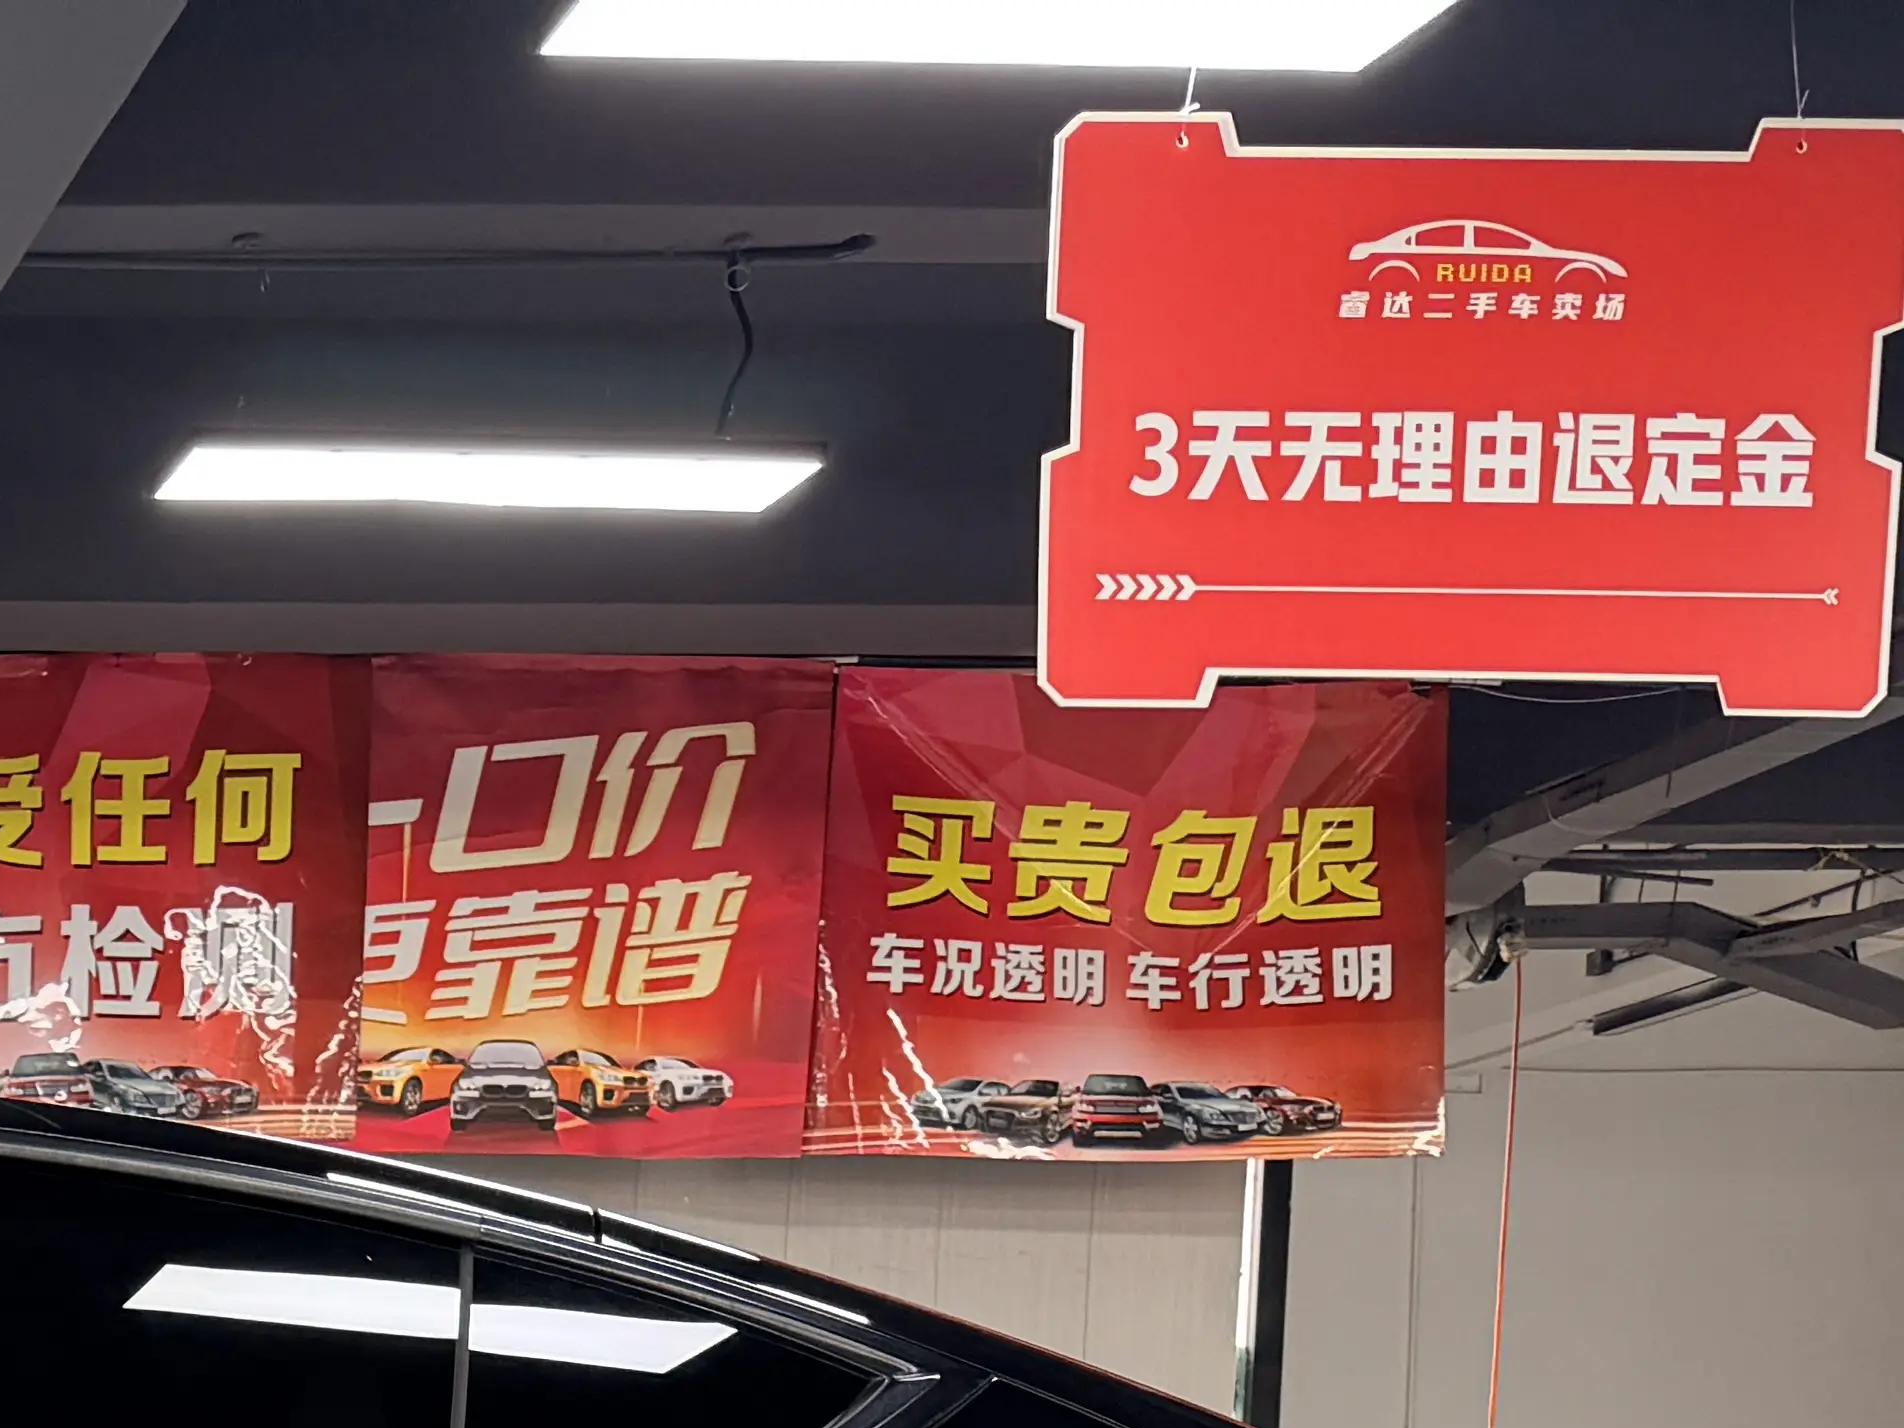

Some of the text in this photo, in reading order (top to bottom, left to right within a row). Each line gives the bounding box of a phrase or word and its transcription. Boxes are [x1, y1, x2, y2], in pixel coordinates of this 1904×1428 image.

[1338, 290, 1626, 321] 睿达二手车卖场
[1436, 263, 1532, 283] RUIDA
[1128, 409, 1816, 509] 3天无理由退定金
[886, 794, 1382, 926] 买贵包退
[866, 932, 1392, 1011] 车况透明 车行透明
